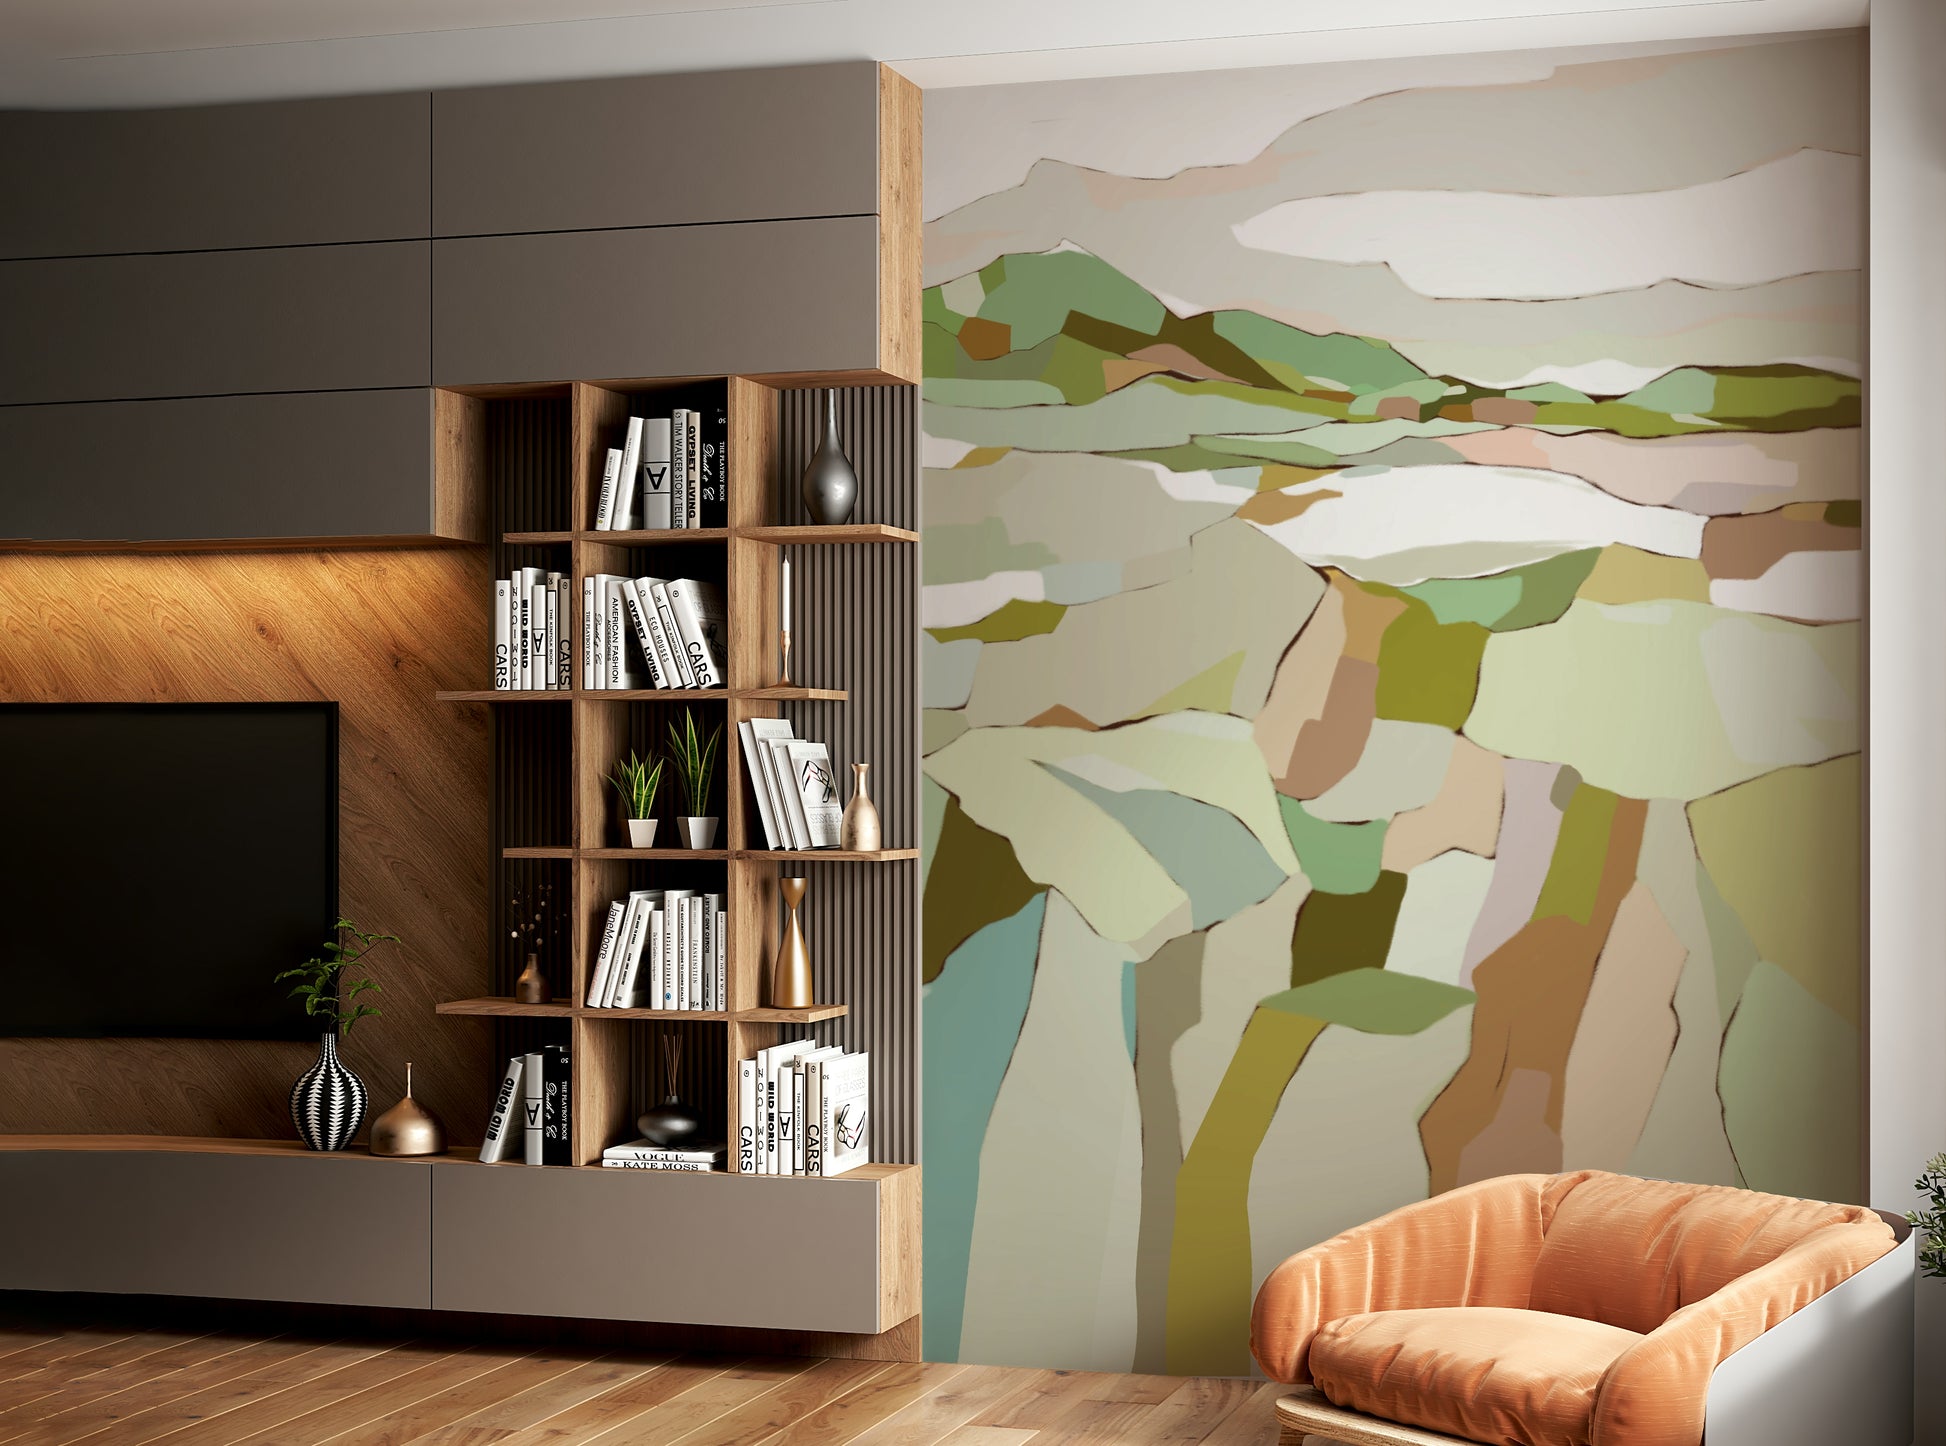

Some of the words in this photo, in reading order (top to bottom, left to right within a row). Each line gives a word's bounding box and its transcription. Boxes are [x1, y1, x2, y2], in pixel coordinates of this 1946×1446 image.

[674, 422, 683, 439] TIM
[674, 440, 683, 472] WALKER
[674, 475, 683, 502] STORY
[674, 503, 683, 529] TELLER
[628, 600, 646, 640] GYPSET
[644, 646, 660, 682] LIVING
[650, 616, 658, 631] ECO
[656, 635, 670, 663] HOUSES
[496, 644, 508, 688] CARS
[560, 640, 571, 686] CARS
[688, 642, 712, 686] CARS
[623, 1161, 658, 1170] KATE
[662, 1162, 699, 1170] MOSS
[634, 1152, 684, 1162] VOGUE
[740, 1126, 752, 1171] CARS
[808, 1124, 820, 1172] CARS
